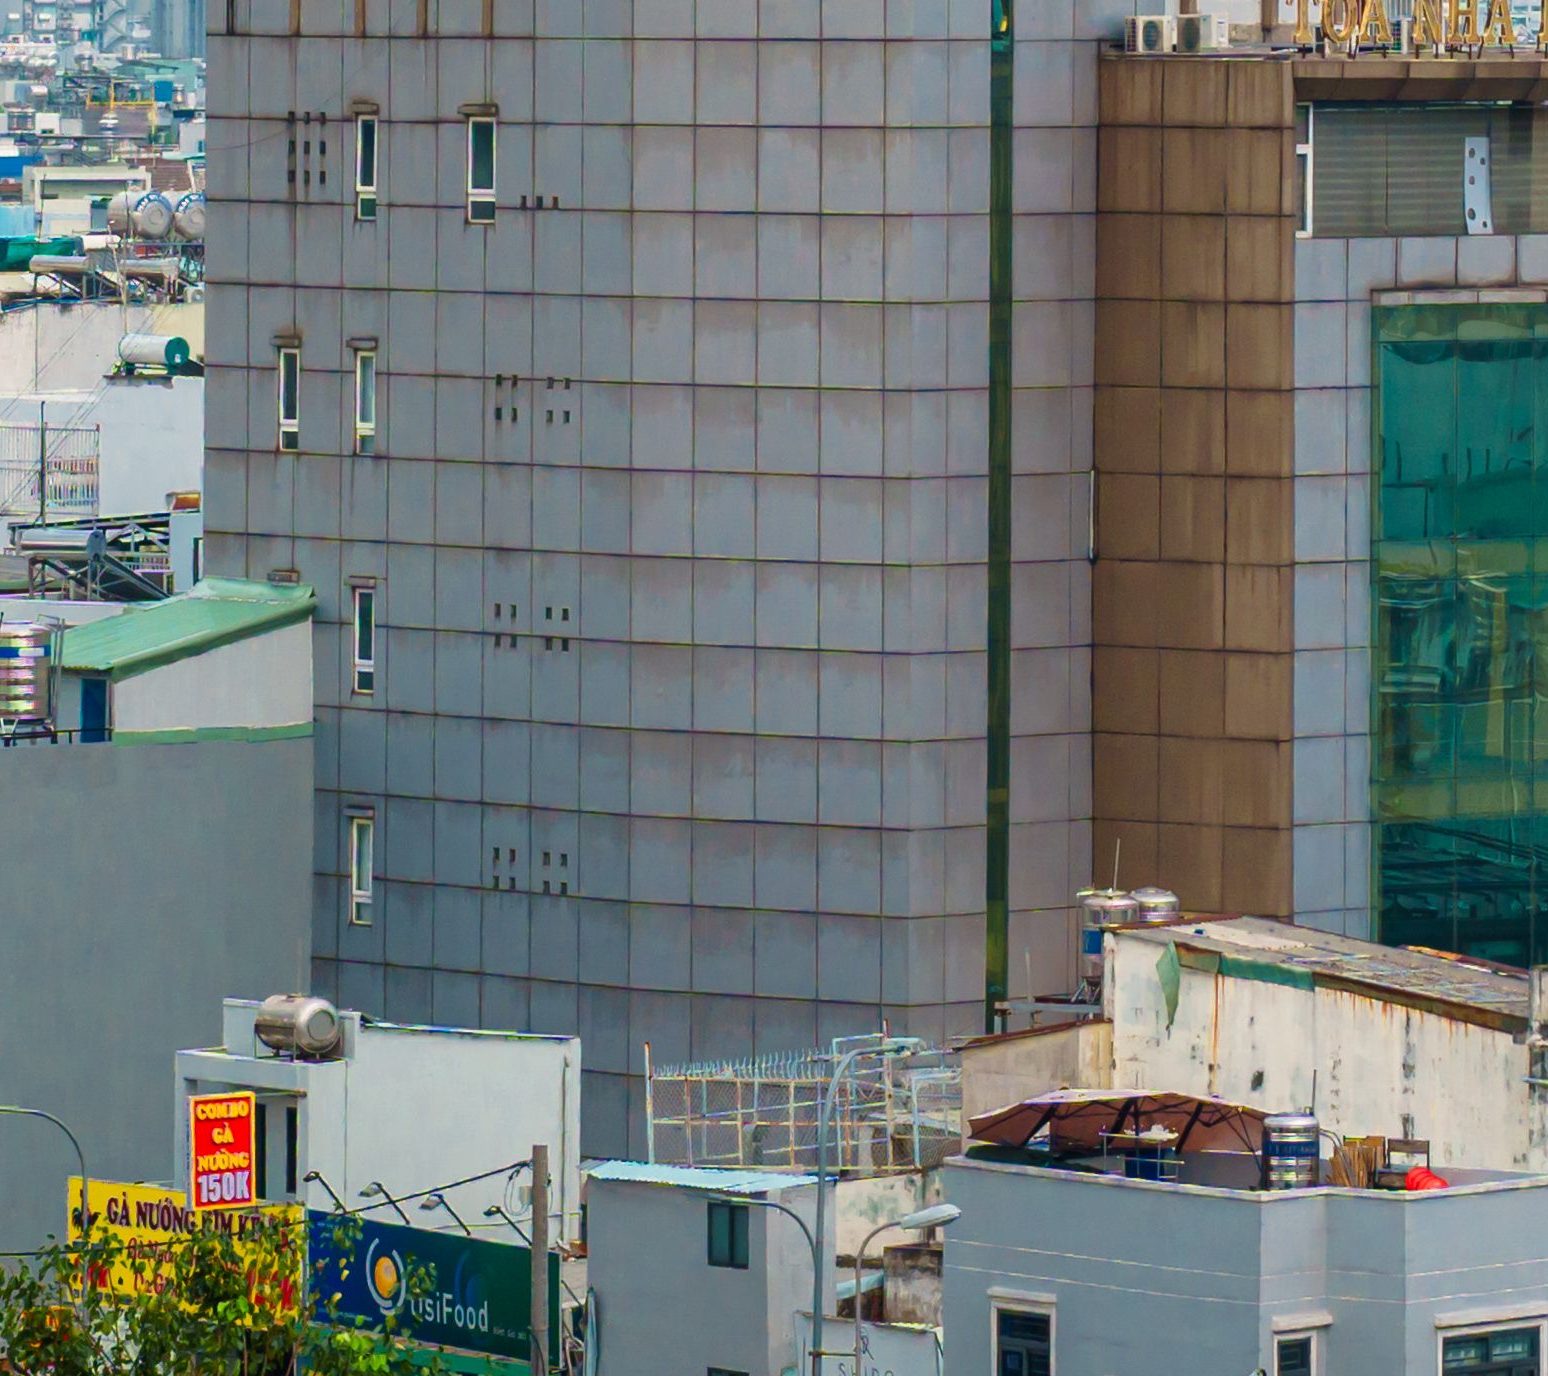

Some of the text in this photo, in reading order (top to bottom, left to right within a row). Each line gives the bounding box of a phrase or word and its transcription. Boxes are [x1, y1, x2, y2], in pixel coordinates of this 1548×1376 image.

[196, 1100, 249, 1121] COMBO
[212, 1121, 234, 1145] GÀ
[197, 1170, 250, 1203] 150K
